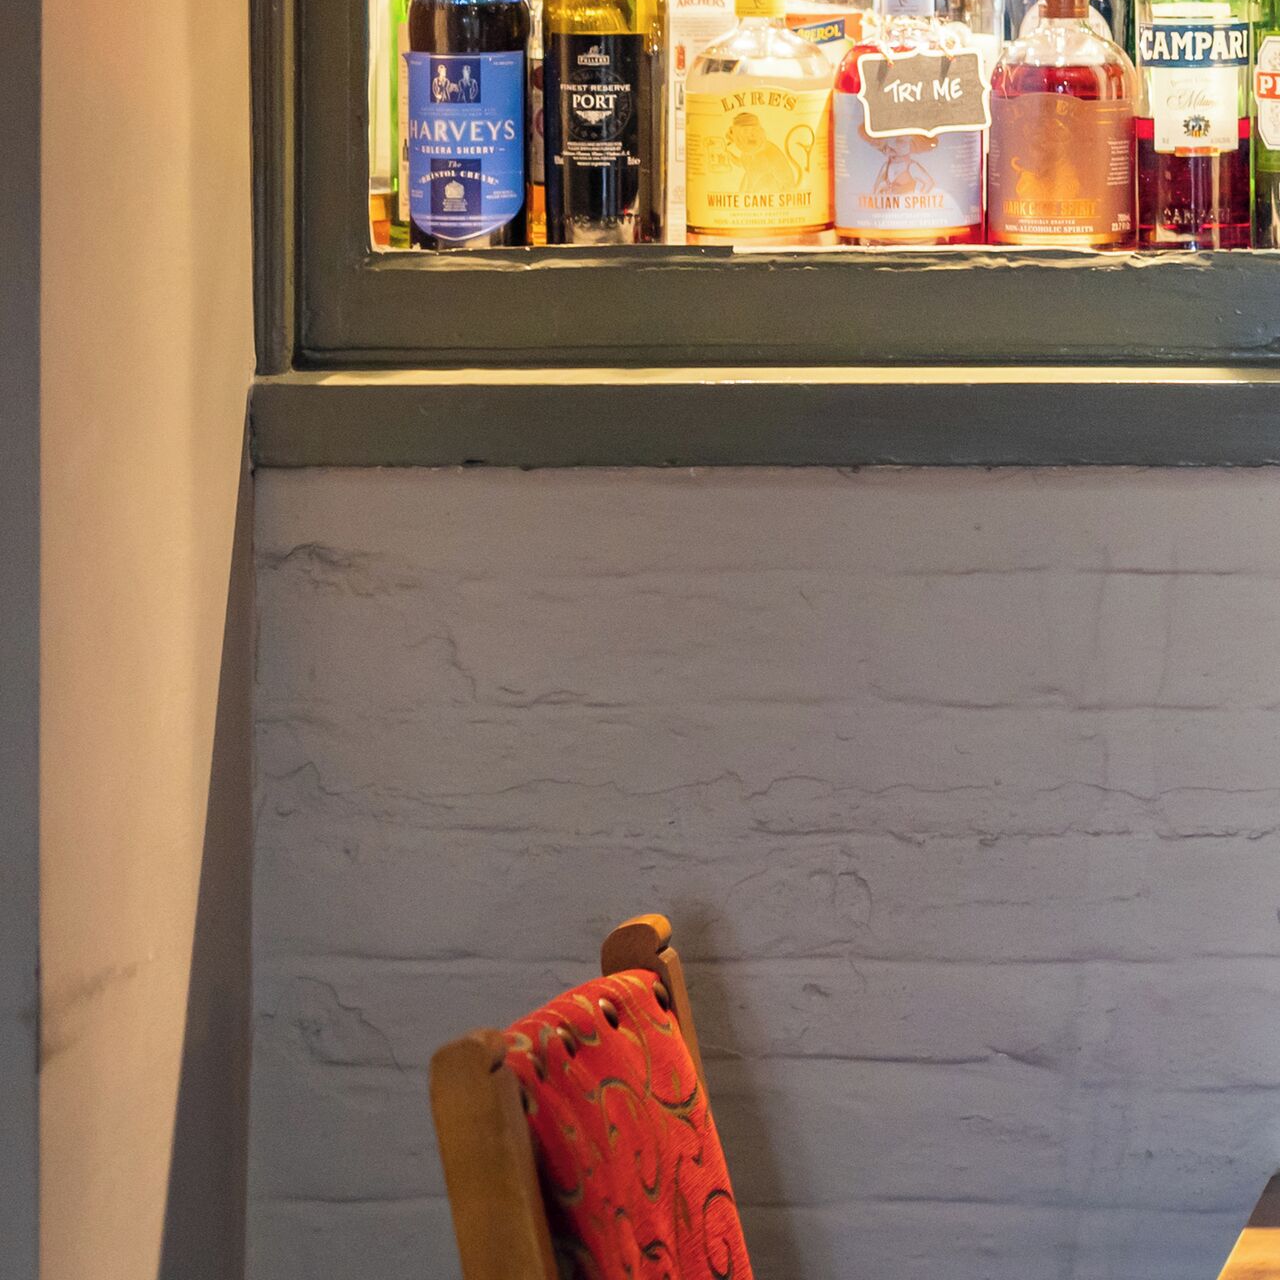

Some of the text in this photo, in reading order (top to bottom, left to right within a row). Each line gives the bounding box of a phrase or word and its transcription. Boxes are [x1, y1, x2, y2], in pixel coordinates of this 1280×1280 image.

[1140, 30, 1249, 62] CAMPARI
[560, 83, 631, 92] FINEST RESERVE
[884, 77, 963, 103] TRY ME
[572, 93, 618, 110] PORT
[720, 90, 799, 112] LYRE'S
[410, 119, 515, 141] HARVEYS
[421, 145, 495, 155] SOLERA SHERRY
[706, 192, 812, 209] WHITE CANE SPIRIT
[858, 193, 945, 209] ITALIAN SPRITZ
